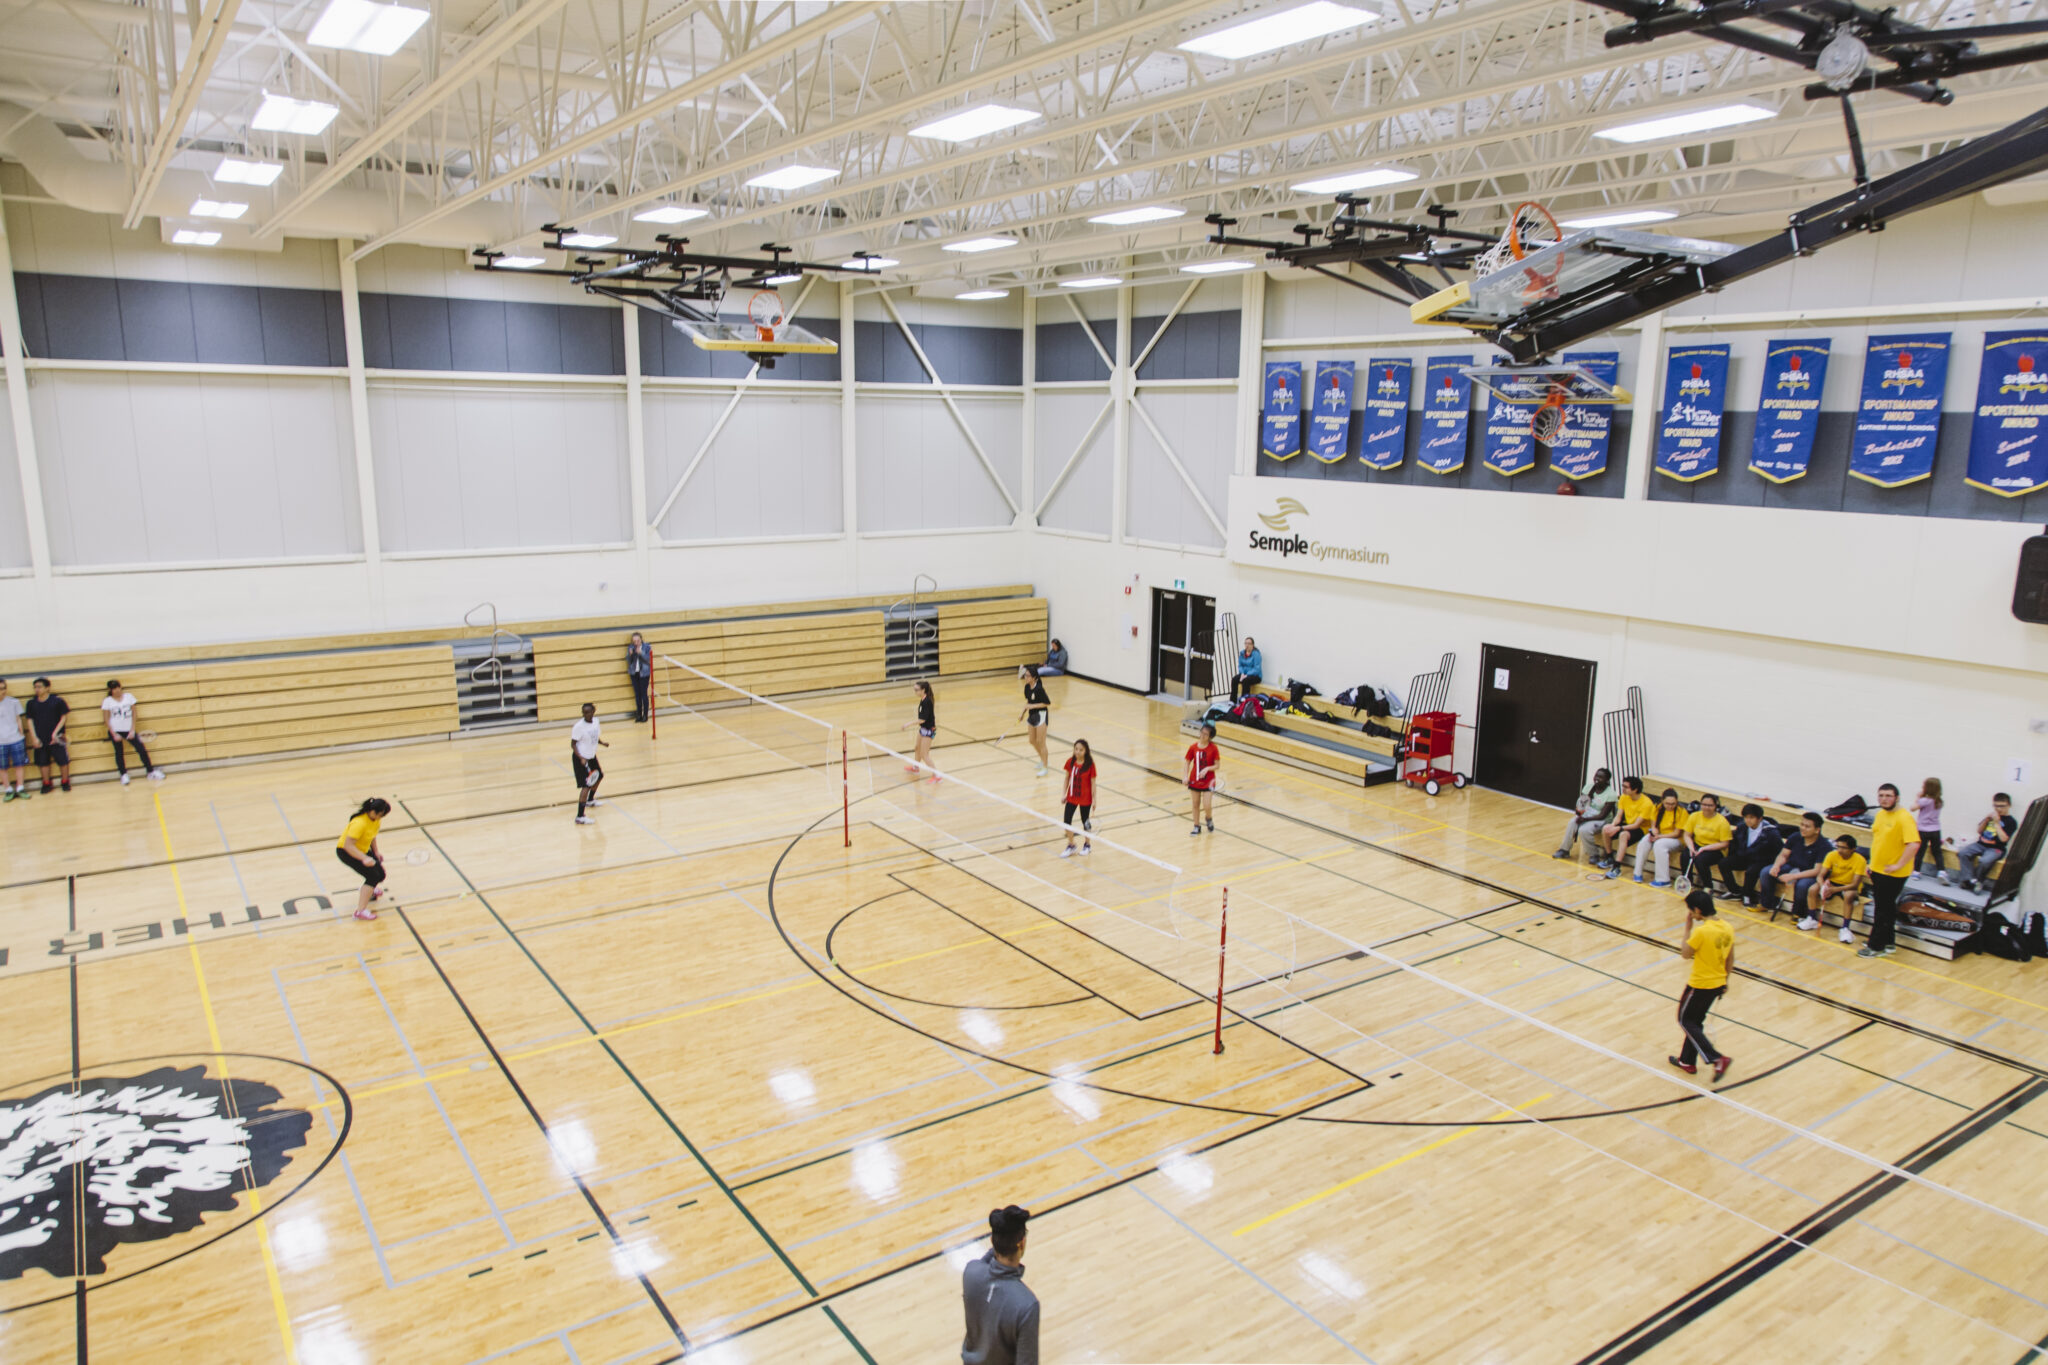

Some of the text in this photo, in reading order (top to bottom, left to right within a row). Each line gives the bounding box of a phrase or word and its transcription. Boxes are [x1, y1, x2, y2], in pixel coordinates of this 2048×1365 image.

[1884, 368, 1925, 379] RHSAA
[1762, 399, 1820, 410] SPORTSMANSHIP
[1863, 399, 1939, 410] SPORTSMANSHIP
[1425, 410, 1468, 420] SPORTSMANSHIP
[1776, 410, 1803, 421] AWARD
[1882, 411, 1915, 422] AWARD
[1906, 424, 1937, 432] SCHOOL
[2000, 417, 2040, 429] AWARD
[1664, 427, 1719, 438] SPORTSMANSHIP
[1678, 437, 1703, 447] AWARD
[1864, 436, 1927, 456] Basketball
[1249, 530, 1390, 566] Semple Gymnasium
[1497, 674, 1505, 687] 2
[2013, 766, 2024, 782] 1
